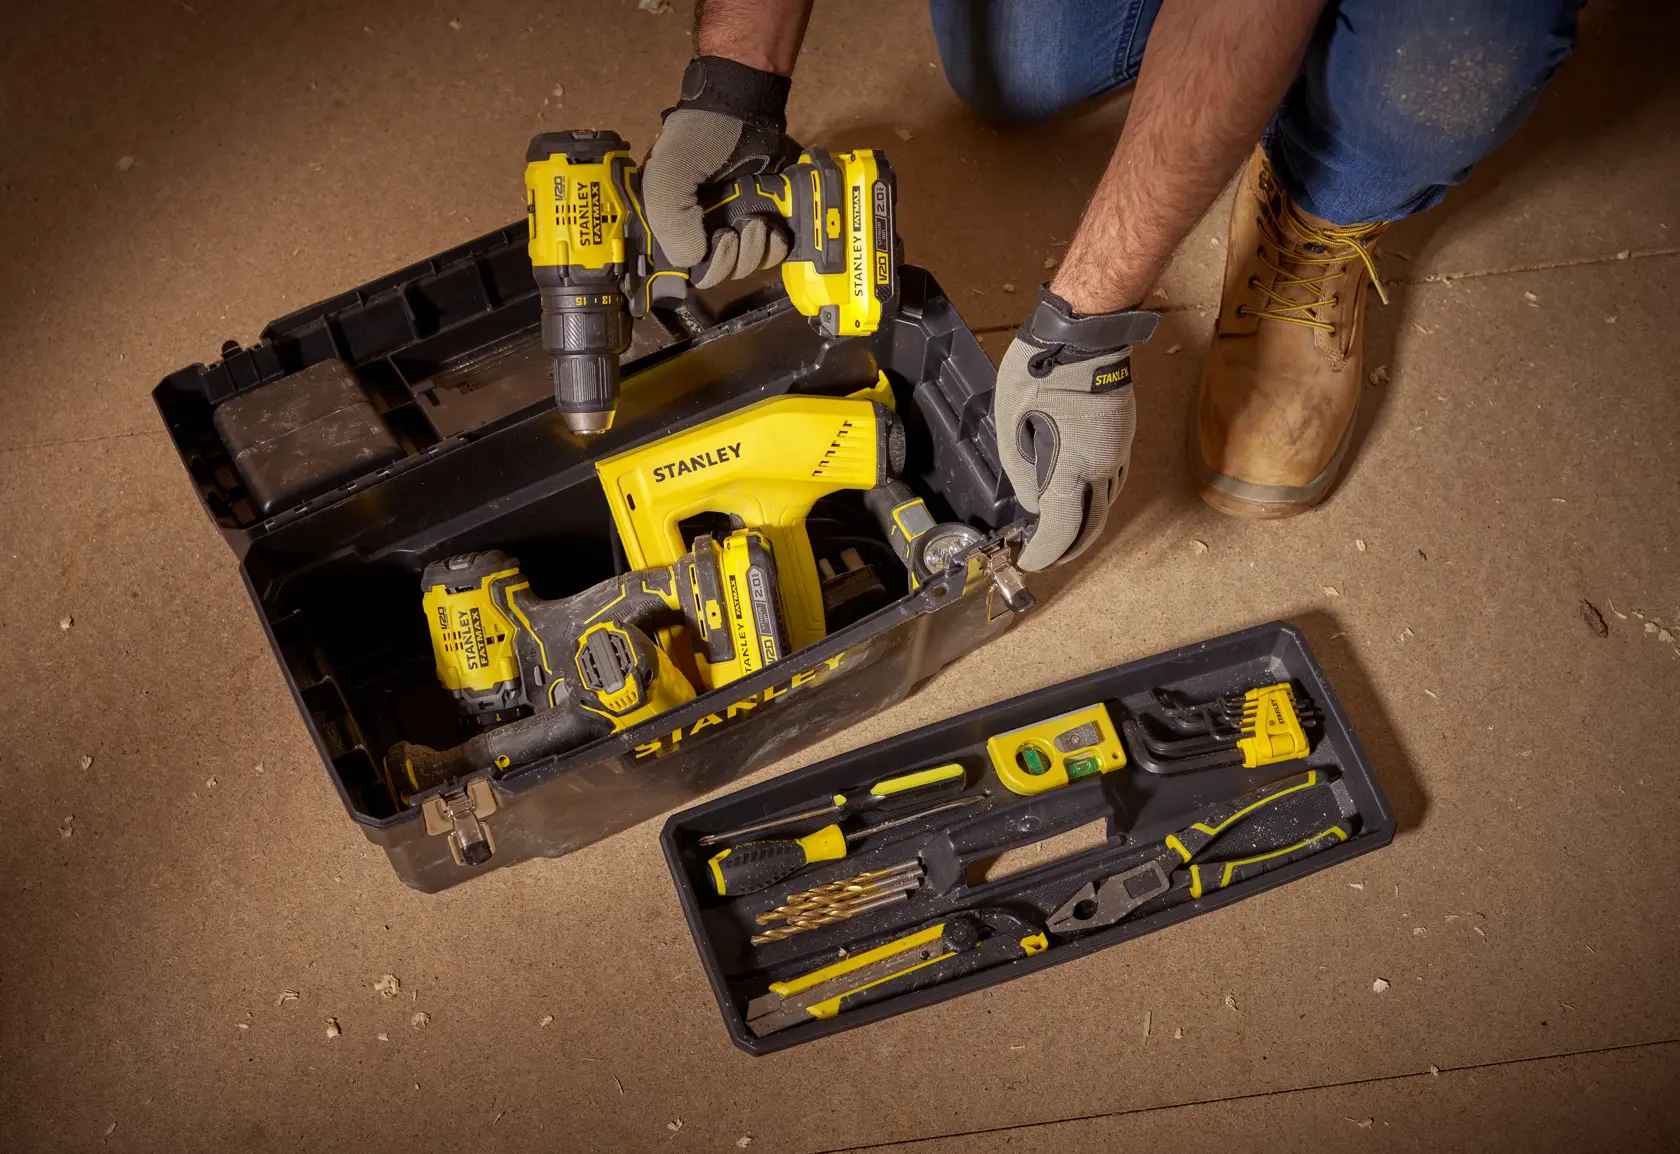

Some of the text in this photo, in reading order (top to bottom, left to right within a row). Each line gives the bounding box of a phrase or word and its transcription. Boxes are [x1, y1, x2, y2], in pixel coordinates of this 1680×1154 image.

[554, 176, 563, 200] V20
[578, 183, 590, 246] STANLEY
[591, 184, 602, 244] FATMAX
[853, 236, 863, 297] STANLEY
[879, 256, 888, 281] V20
[1095, 367, 1129, 386] STANLEY
[653, 442, 742, 483] STANLEY
[437, 606, 447, 630] V20
[458, 611, 478, 670] STANLEY
[470, 610, 488, 666] FATMAX
[730, 579, 752, 673] TANLEY FATMAX
